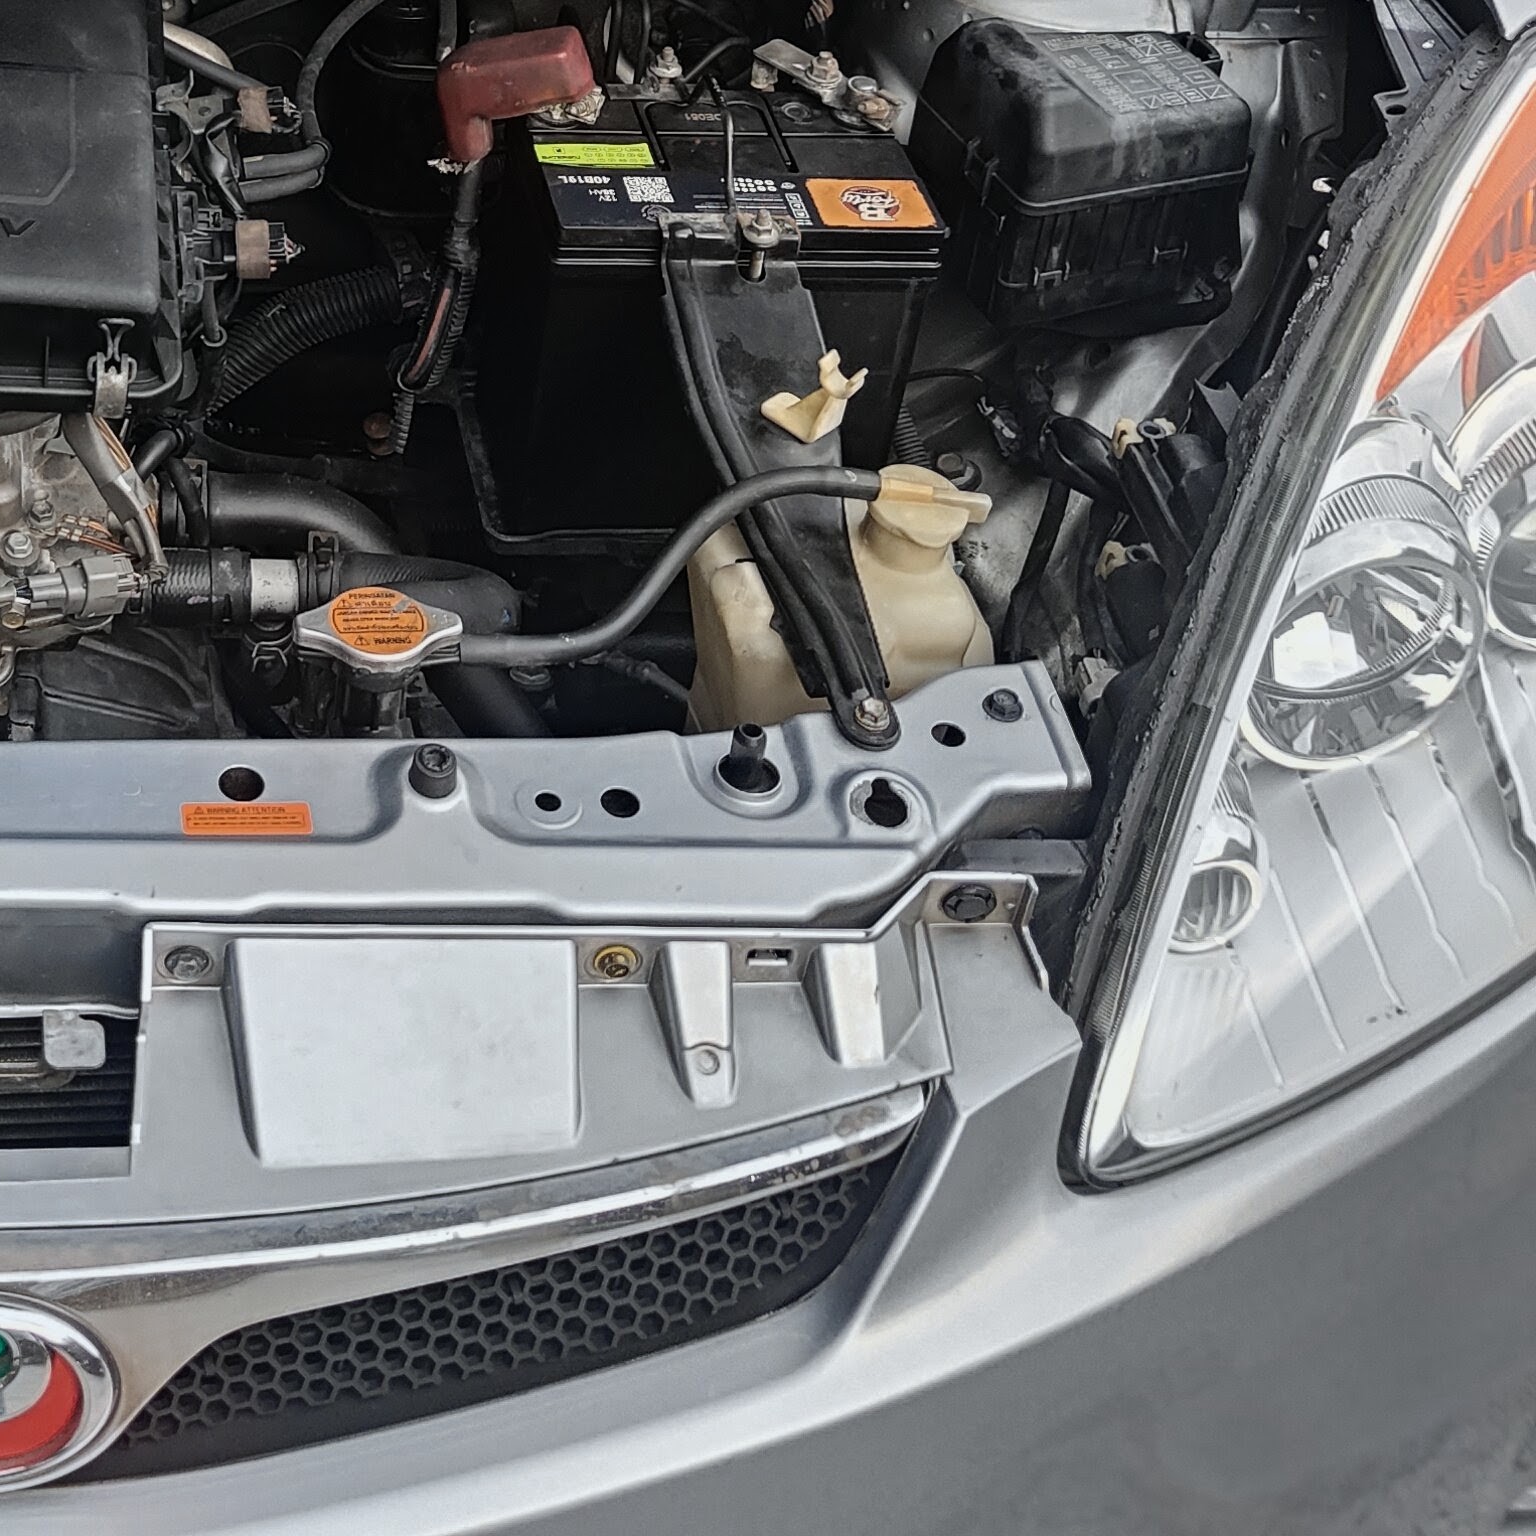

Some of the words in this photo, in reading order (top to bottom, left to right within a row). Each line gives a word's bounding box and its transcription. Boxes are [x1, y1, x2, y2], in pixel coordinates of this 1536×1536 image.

[558, 175, 611, 184] 40B19L
[598, 194, 618, 202] 12V
[842, 189, 900, 208] Forty
[858, 203, 897, 221] B
